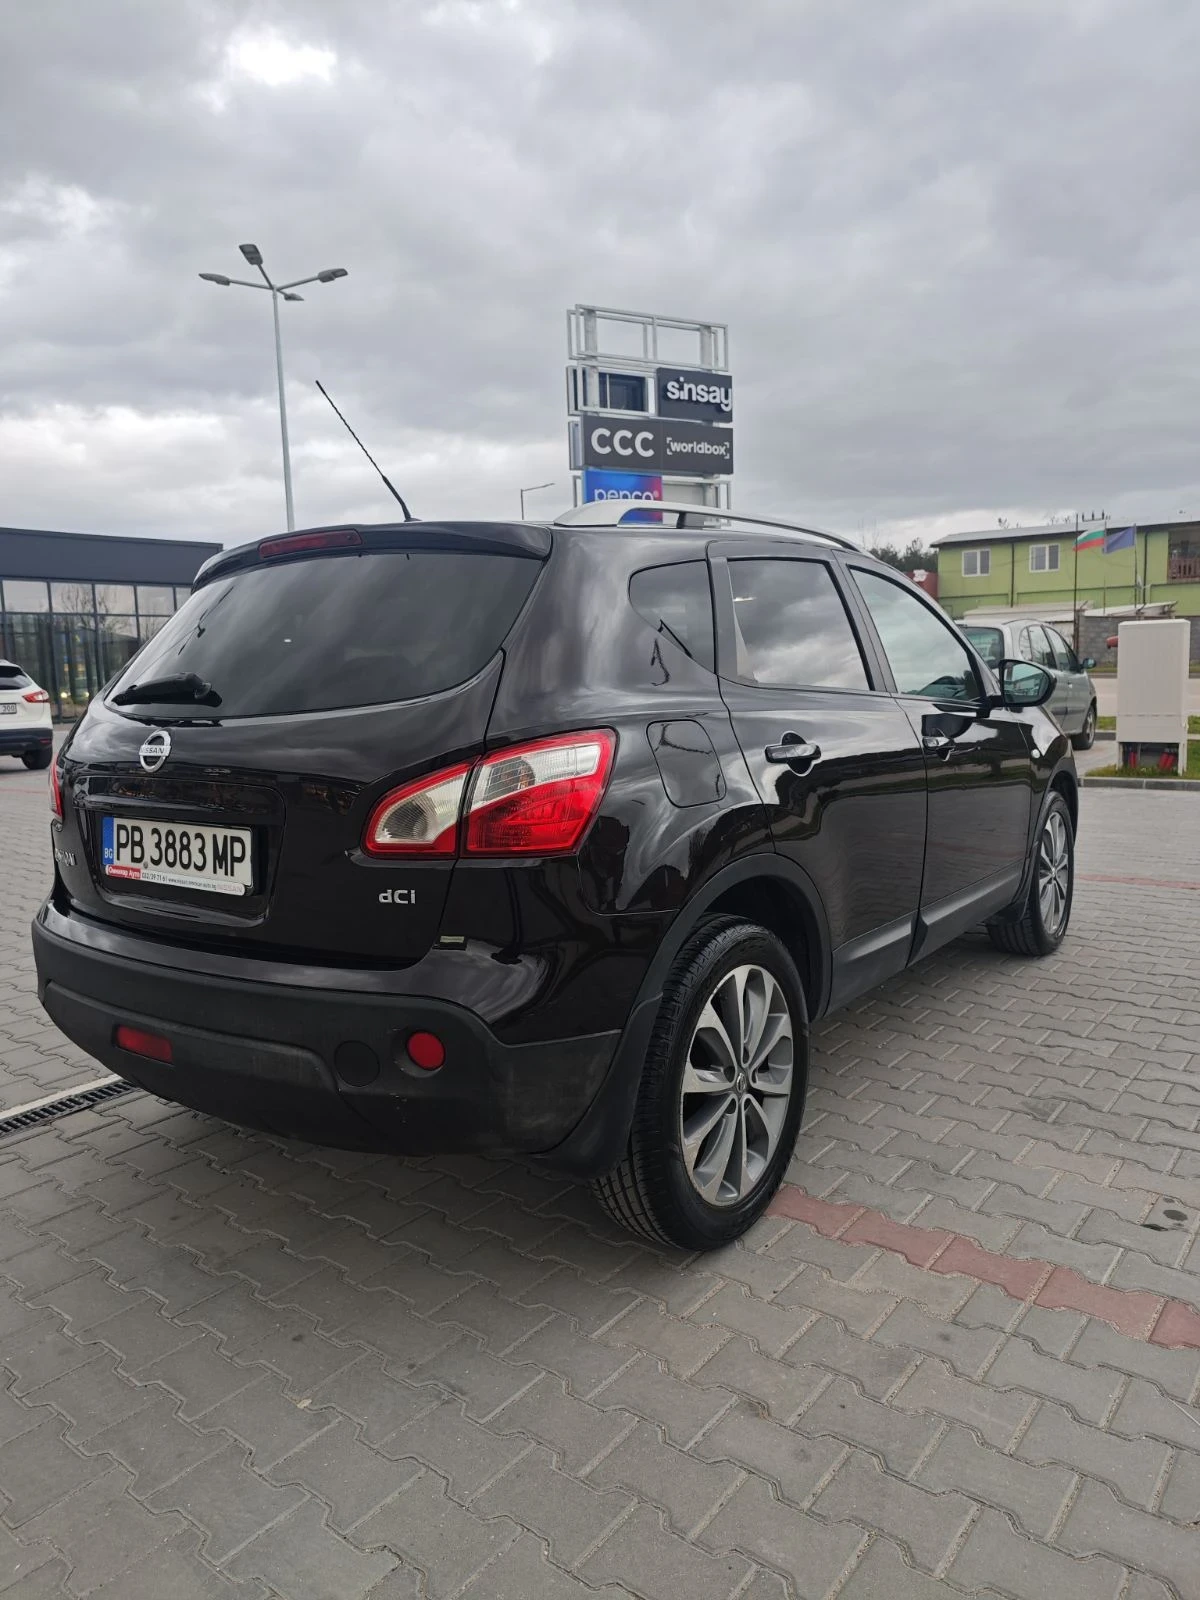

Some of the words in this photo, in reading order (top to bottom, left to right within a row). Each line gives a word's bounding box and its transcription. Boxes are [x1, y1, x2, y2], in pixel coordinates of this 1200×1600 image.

[667, 376, 732, 412] sinsay
[591, 428, 655, 458] CCC
[104, 848, 113, 860] BG
[116, 823, 145, 864] PB
[150, 828, 207, 872] 3883
[212, 833, 246, 877] MP
